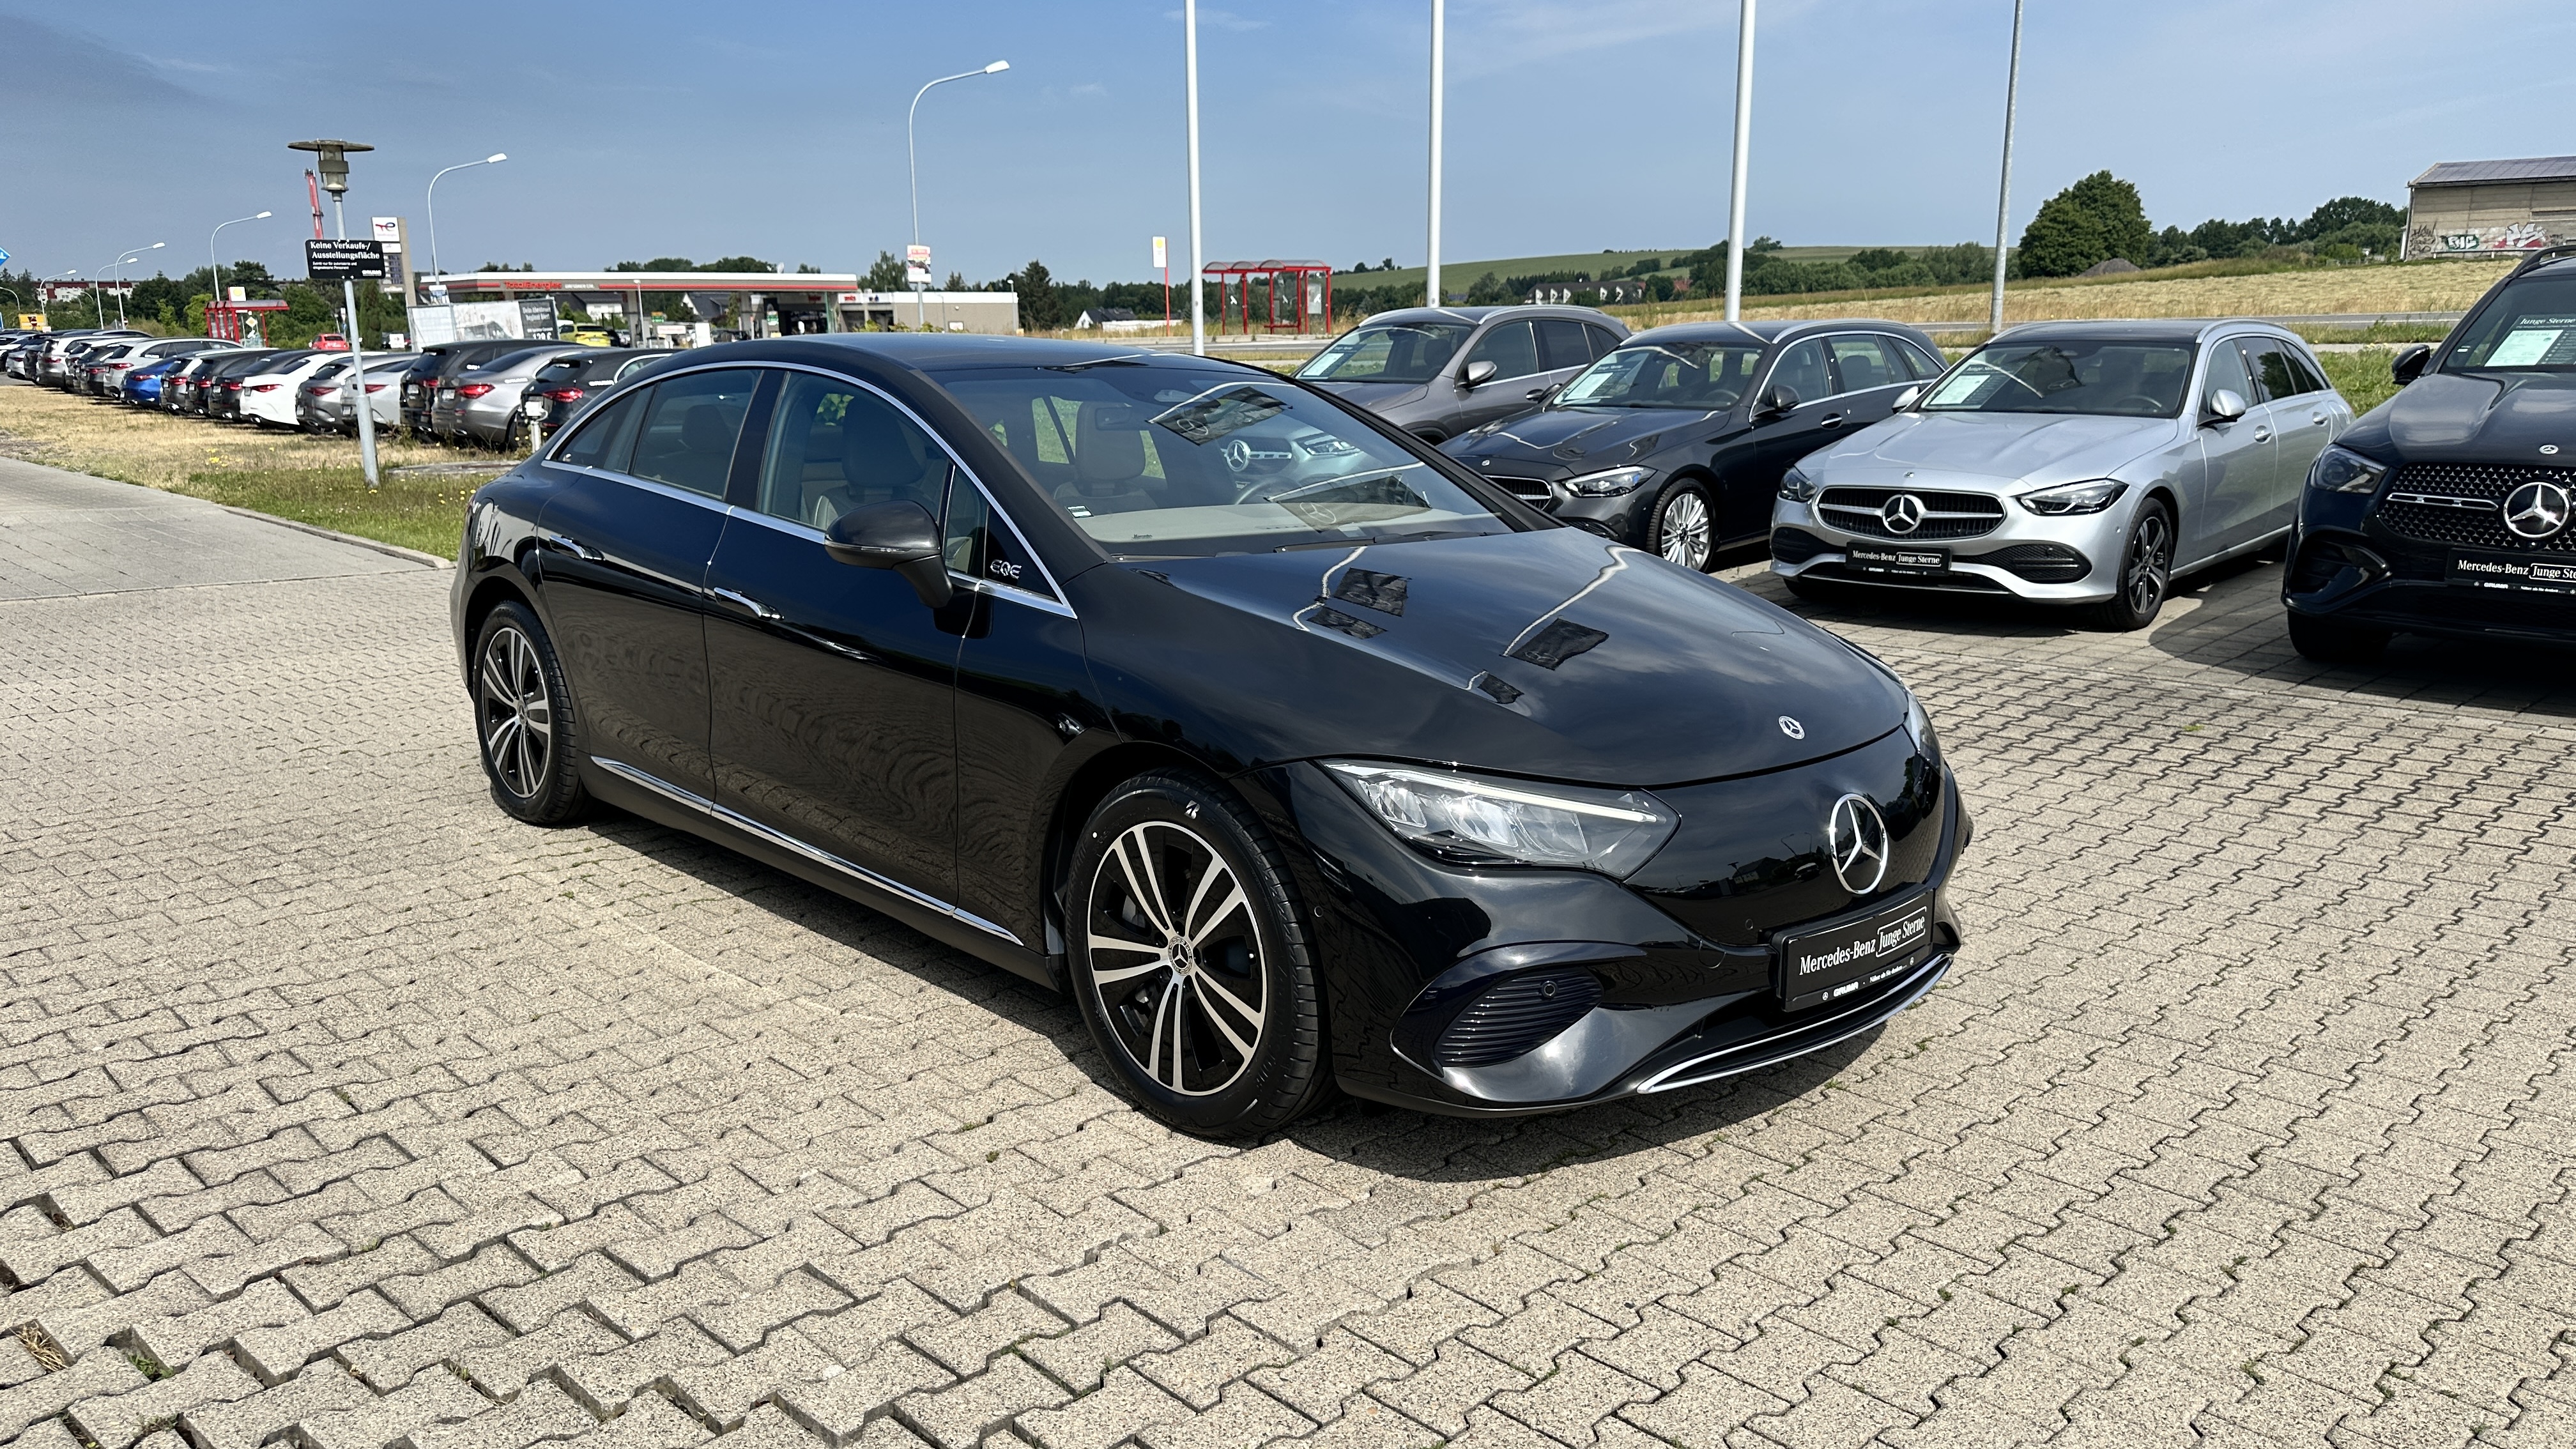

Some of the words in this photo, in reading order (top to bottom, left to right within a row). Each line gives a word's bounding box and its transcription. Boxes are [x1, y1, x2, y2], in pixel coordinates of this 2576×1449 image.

[310, 241, 332, 249] Keine
[333, 241, 371, 250] Verkaufs-/
[312, 251, 379, 260] Ausstellungsfläche
[504, 280, 562, 290] TotalEnergies
[1853, 550, 1896, 562] Mercedes-Benz
[1898, 554, 1917, 564] Junge
[1917, 555, 1940, 565] Sterne
[990, 560, 1022, 579] EQE
[2457, 559, 2530, 575] Mercedes-Benz
[2532, 565, 2561, 579] Junge
[1799, 939, 1876, 976] Mercedes-Benz
[1878, 930, 1901, 952] Junge
[1902, 916, 1925, 939] Sterne
